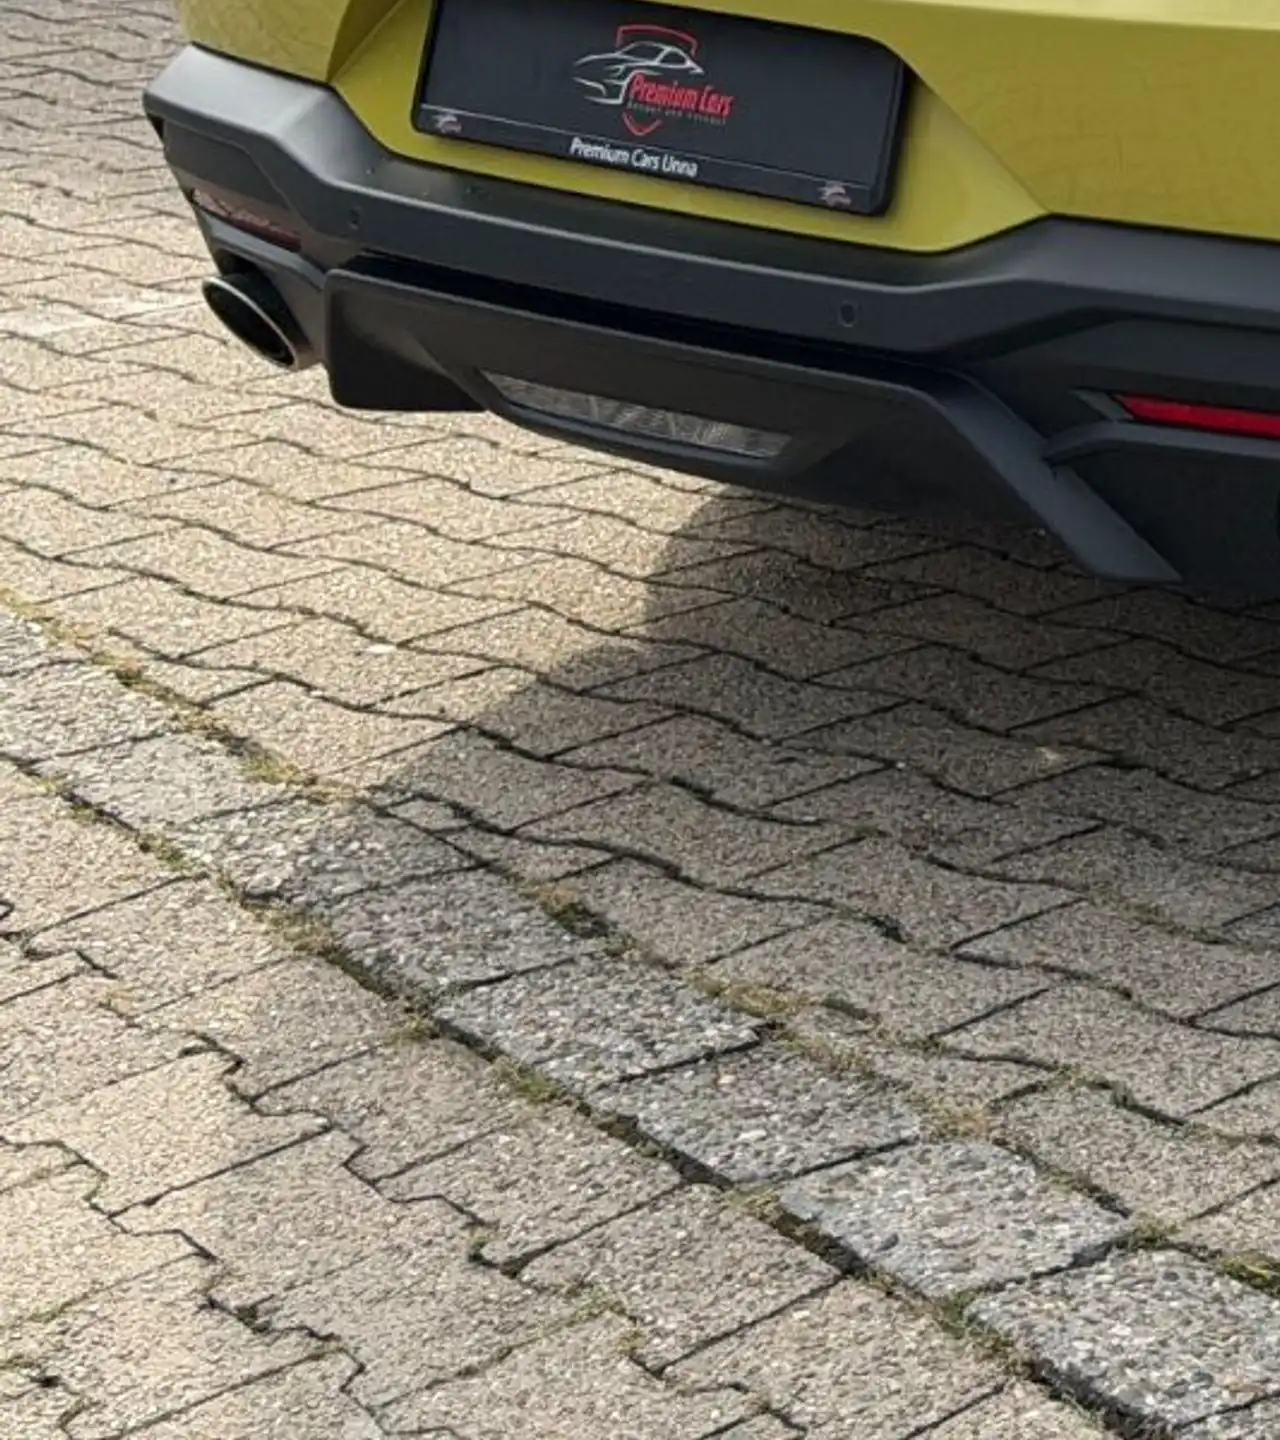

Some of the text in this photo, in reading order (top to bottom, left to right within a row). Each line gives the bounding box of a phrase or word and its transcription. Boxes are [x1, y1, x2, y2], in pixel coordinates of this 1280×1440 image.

[629, 73, 697, 110] Premium
[699, 83, 734, 117] Cars
[569, 136, 699, 178] Premium Cars Unna
